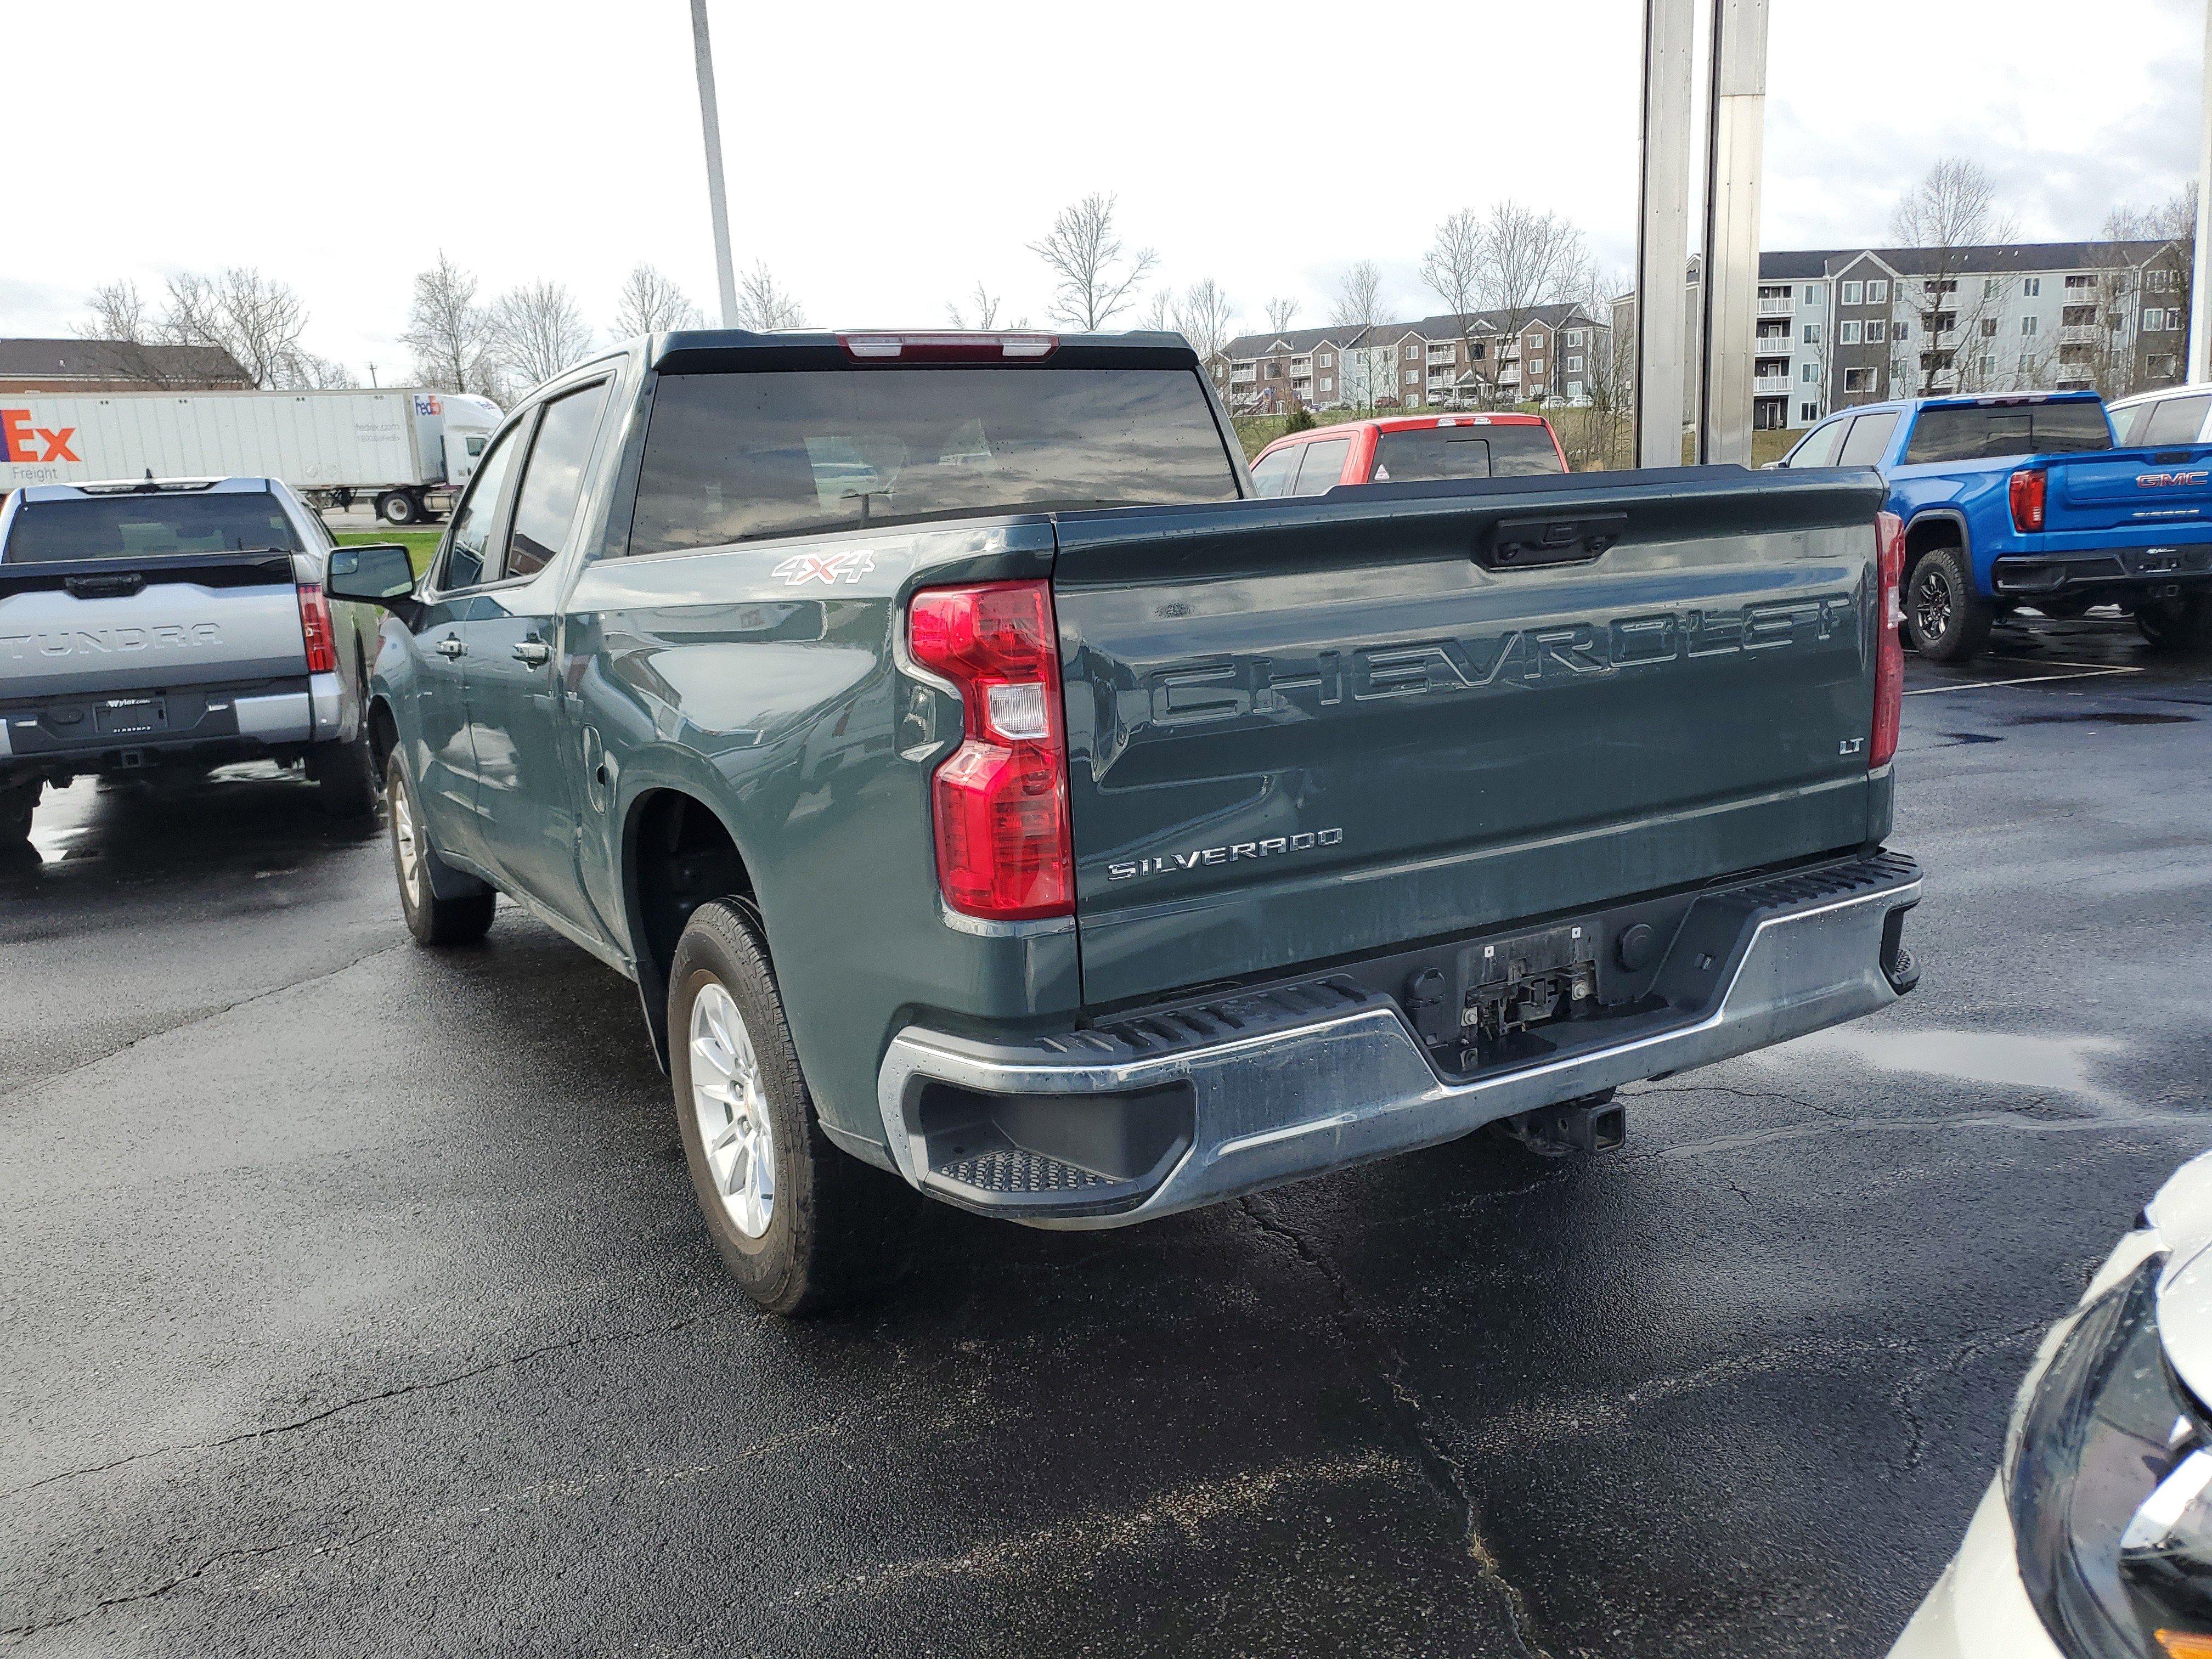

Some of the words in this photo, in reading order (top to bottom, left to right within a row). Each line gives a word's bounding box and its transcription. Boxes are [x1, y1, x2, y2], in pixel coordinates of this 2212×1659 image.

[13, 467, 58, 482] Freight
[2136, 471, 2209, 488] GMC
[0, 622, 223, 659] TUNDRA
[1150, 591, 1850, 726] CHEVROLET
[1839, 737, 1864, 755] LT
[1107, 827, 1342, 882] SILVERADO
